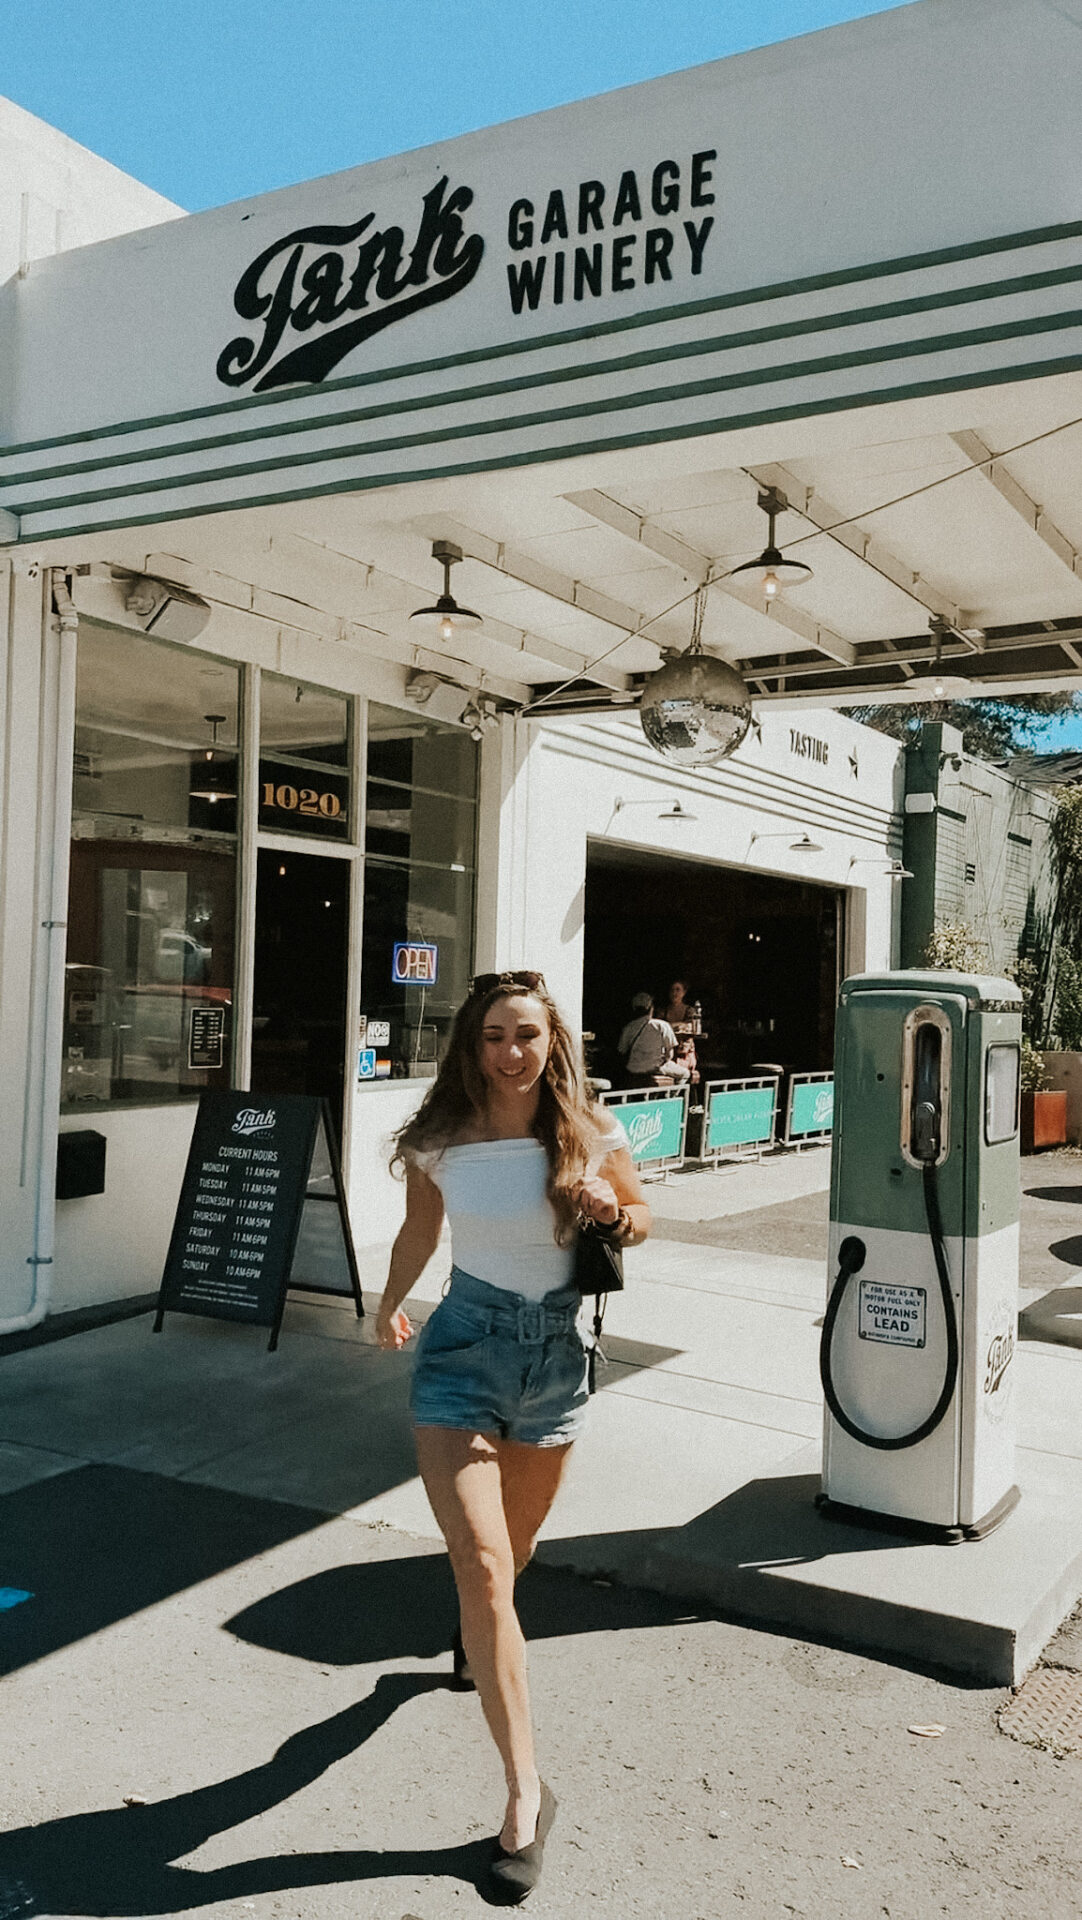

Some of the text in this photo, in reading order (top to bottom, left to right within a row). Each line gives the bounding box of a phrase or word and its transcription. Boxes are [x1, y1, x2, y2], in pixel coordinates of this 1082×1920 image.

[507, 149, 717, 251] GARAGE
[506, 216, 715, 315] WINERY
[216, 175, 484, 392] Tank
[789, 728, 829, 765] TASTING
[262, 783, 340, 817] 1020
[396, 947, 435, 979] OPEN
[231, 1108, 276, 1135] Tank
[218, 1146, 279, 1162] CURRENT HOURS
[202, 1162, 230, 1173] MONDAY
[199, 1177, 228, 1189] TUESDAY
[195, 1194, 235, 1207] WEDNESDAY
[193, 1210, 227, 1223] THURSDAY
[188, 1226, 213, 1238] FRIDAY
[185, 1243, 221, 1256] SATURDAY
[182, 1259, 210, 1271] SUNDAY
[866, 1304, 919, 1320] CONTAINS
[874, 1316, 910, 1332] LEAD
